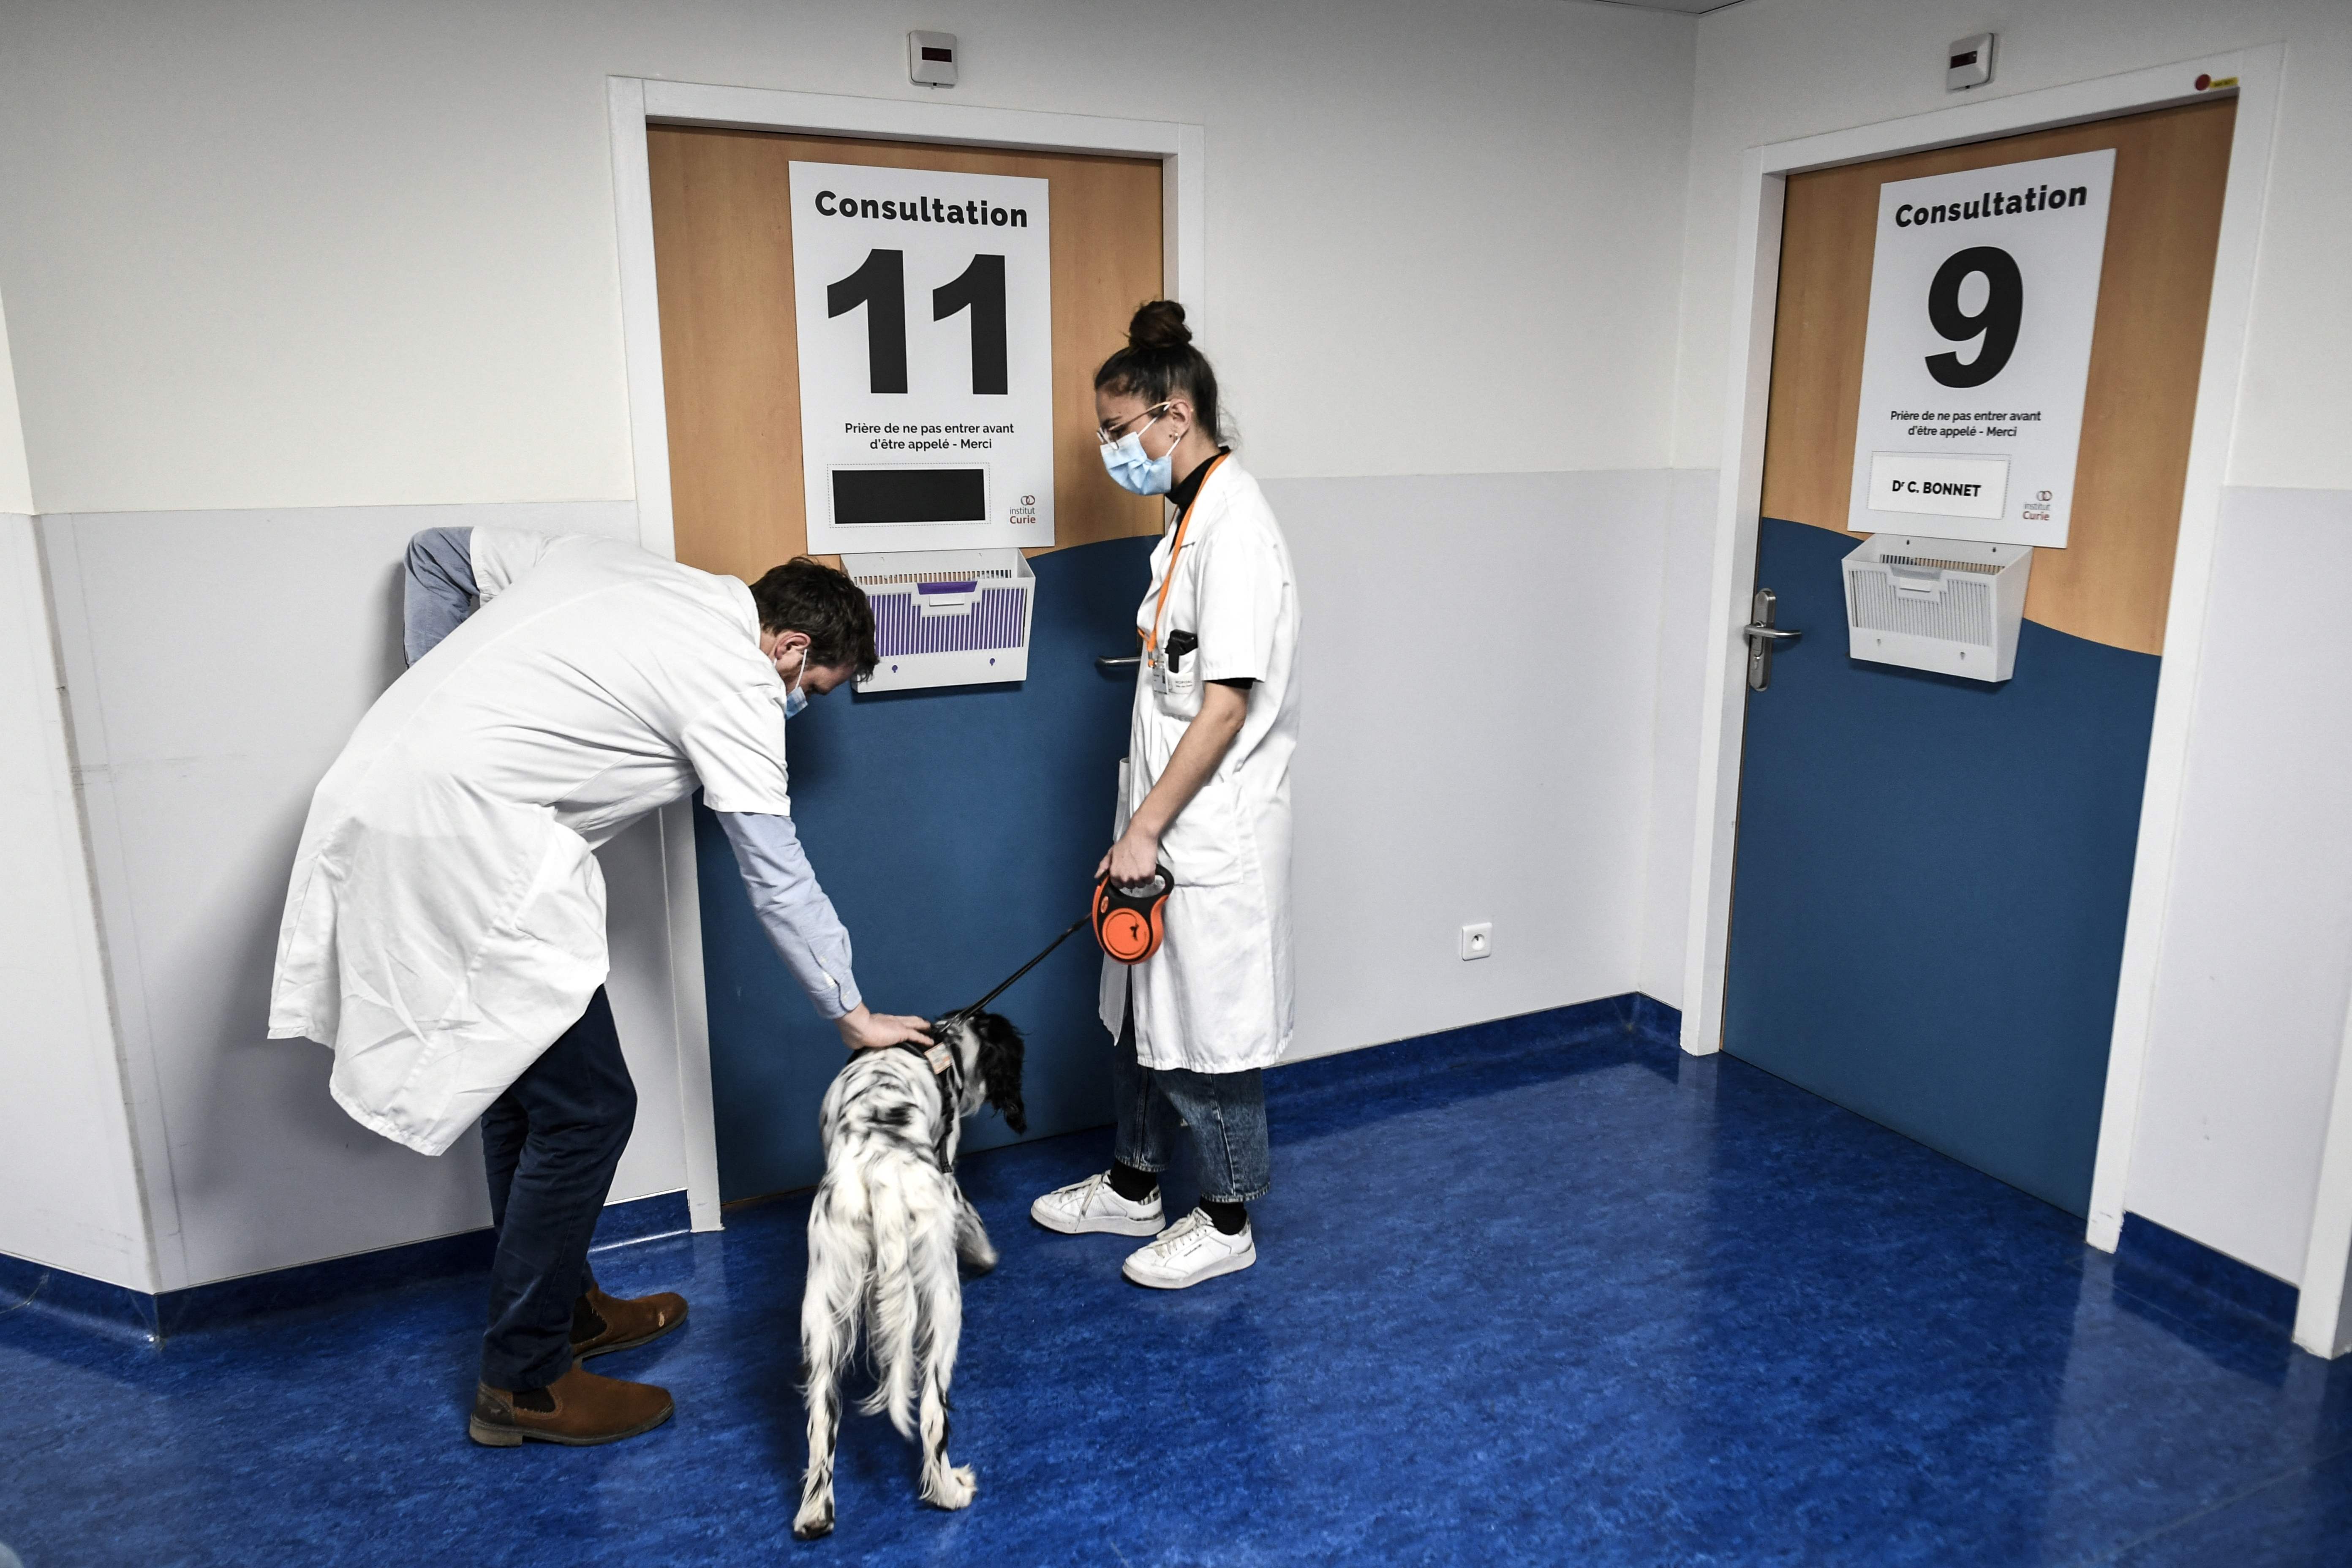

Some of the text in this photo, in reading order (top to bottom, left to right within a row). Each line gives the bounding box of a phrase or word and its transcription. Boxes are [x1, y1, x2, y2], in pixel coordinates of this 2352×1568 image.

[815, 191, 1027, 228] Consultation
[1895, 185, 2087, 227] Consultation
[827, 248, 1008, 395] 11
[1925, 246, 2023, 388] 9
[1890, 411, 2042, 423] Prière de ne pas entrer avant
[845, 422, 1014, 436] Prière de ne pas entrer avant
[1908, 425, 1938, 436] d'être
[1939, 426, 1977, 438] appelé
[1986, 426, 2017, 437] Merci
[870, 438, 905, 449] d'être
[908, 438, 950, 452] appelé
[961, 438, 992, 449] Merci
[1907, 481, 1919, 493] C.
[1923, 482, 1982, 497] BONNET
[1010, 506, 1035, 515] institut
[2023, 511, 2050, 521] Curie
[1010, 515, 1036, 524] Curie
